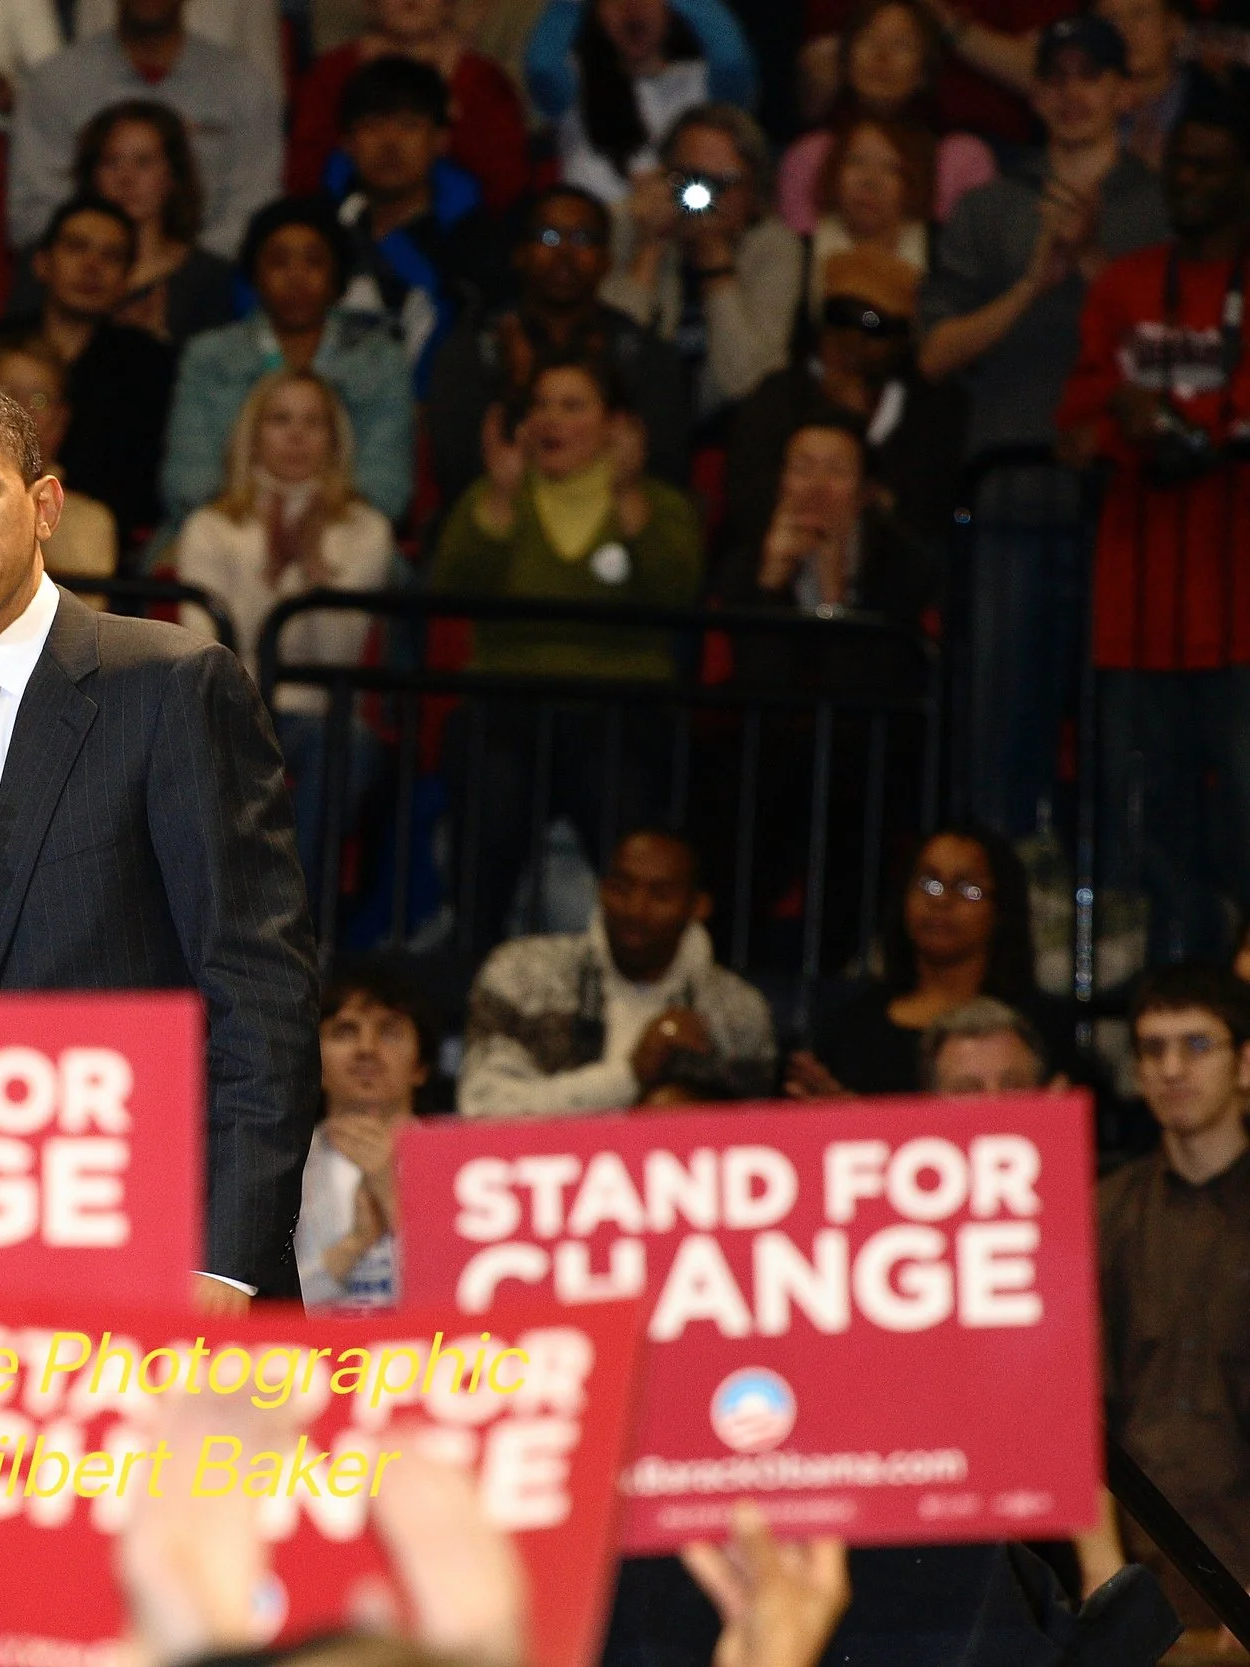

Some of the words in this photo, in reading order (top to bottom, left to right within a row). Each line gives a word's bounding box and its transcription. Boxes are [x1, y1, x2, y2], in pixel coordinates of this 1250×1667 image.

[454, 1143, 800, 1242] STAND
[823, 1134, 1042, 1223] FOR
[353, 1327, 596, 1431] FOR
